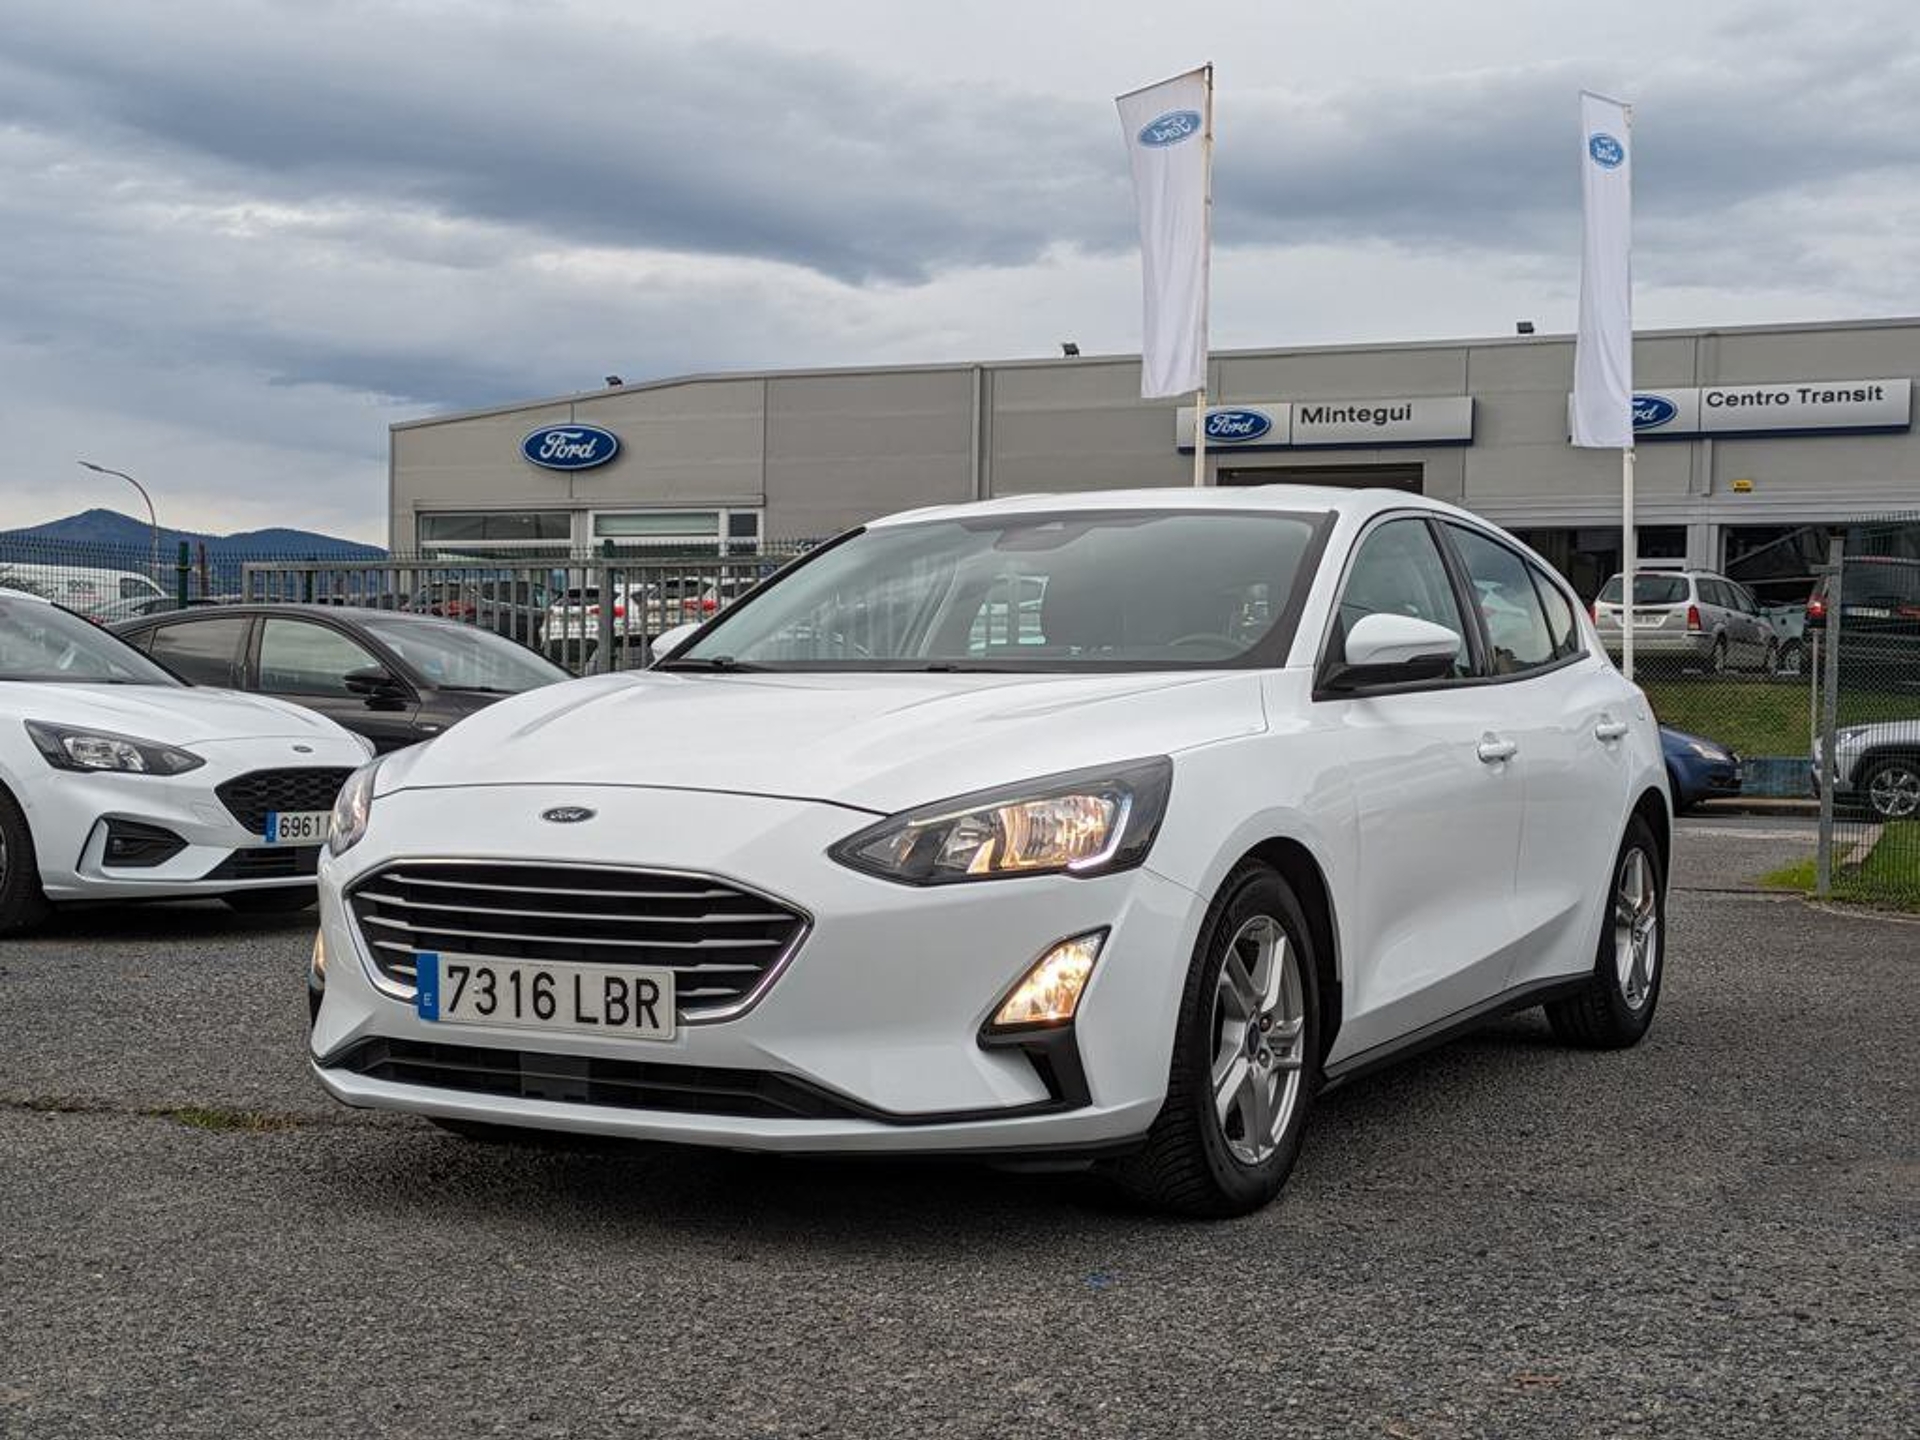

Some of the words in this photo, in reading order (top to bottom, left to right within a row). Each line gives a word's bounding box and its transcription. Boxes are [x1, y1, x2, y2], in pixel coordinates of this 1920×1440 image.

[1706, 391, 1789, 407] Centro
[1797, 385, 1883, 404] Transit
[1208, 414, 1254, 435] Ford
[1301, 404, 1412, 426] Mintegui
[540, 431, 597, 458] Ford
[280, 816, 319, 837] 6961
[423, 993, 431, 1006] E
[447, 966, 556, 1020] 7316
[575, 974, 660, 1028] LBR
